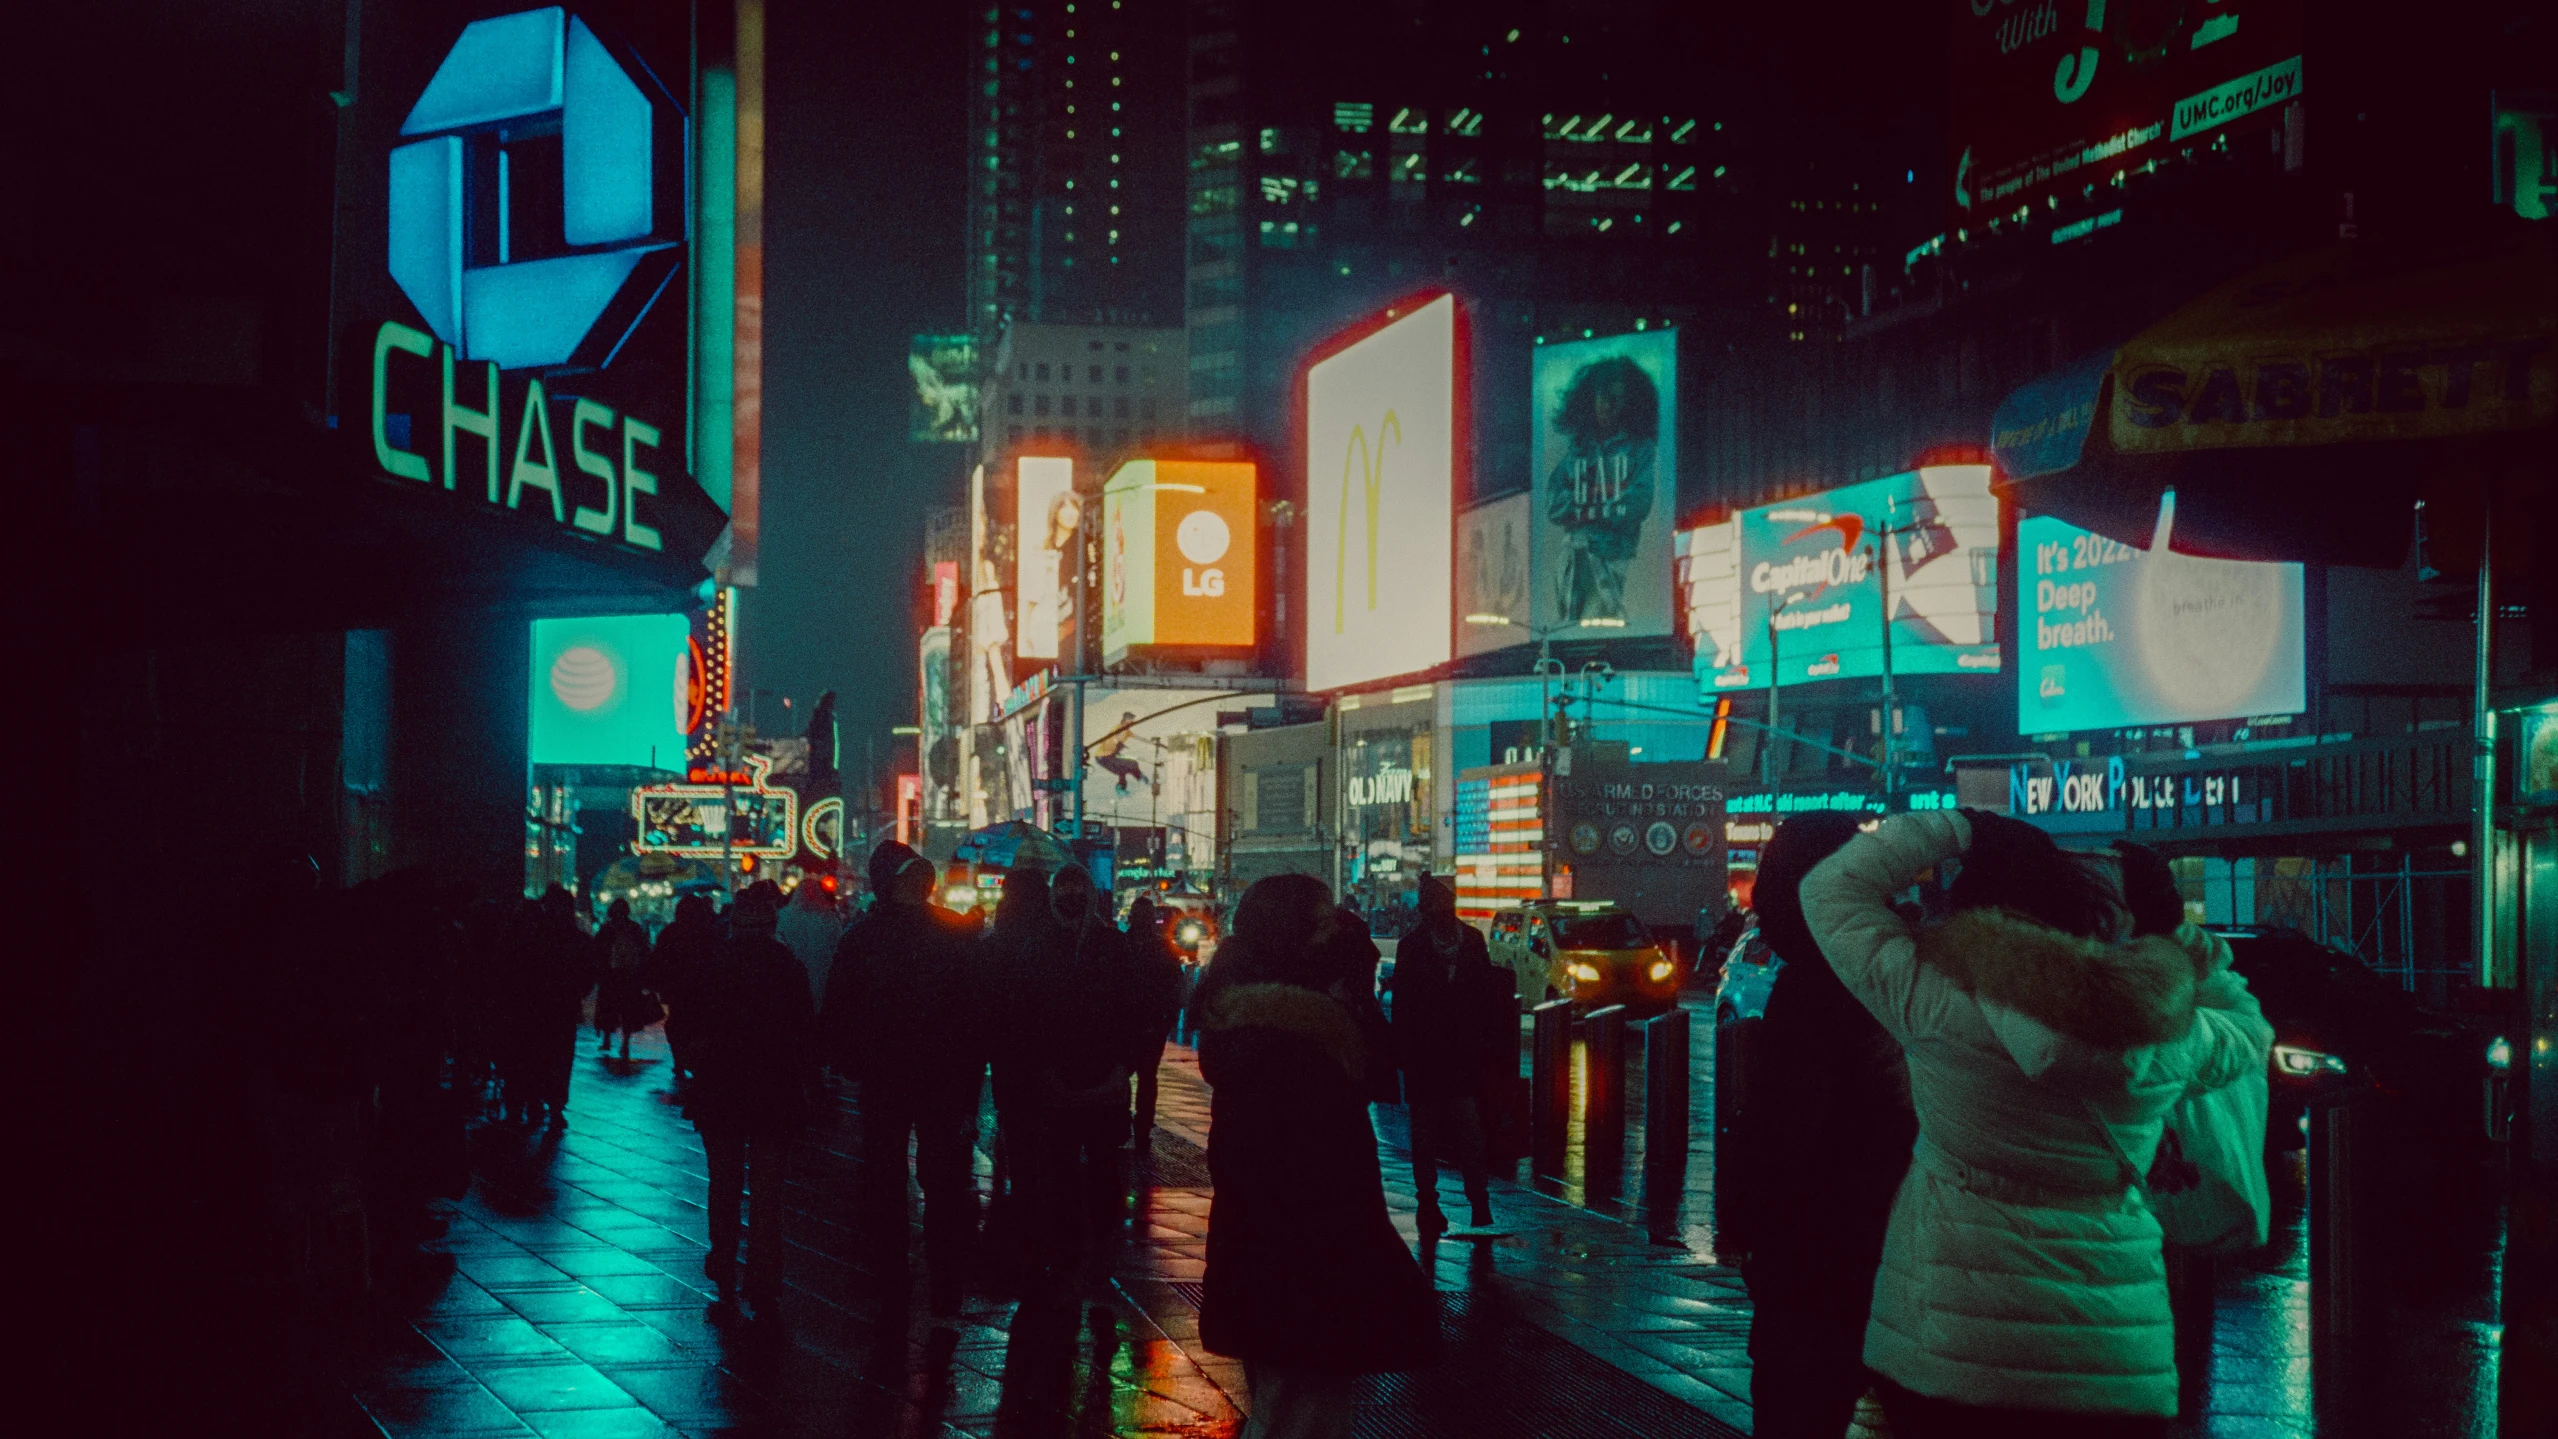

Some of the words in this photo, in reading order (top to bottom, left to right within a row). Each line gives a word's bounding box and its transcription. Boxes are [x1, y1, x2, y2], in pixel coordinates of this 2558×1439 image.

[2178, 69, 2295, 130] UMC.org/Joy
[2123, 336, 2555, 429] SABRETT
[371, 320, 664, 552] CHASE
[1574, 453, 1629, 503] GAP
[2036, 539, 2069, 575] It's
[1182, 568, 1225, 597] LG
[2036, 580, 2097, 616] Deep
[2036, 609, 2115, 650] breath.
[1375, 773, 1412, 804] NAVY
[1657, 784, 1724, 802] FORCES
[2053, 760, 2104, 812] YORK
[2108, 754, 2176, 810] POLCE
